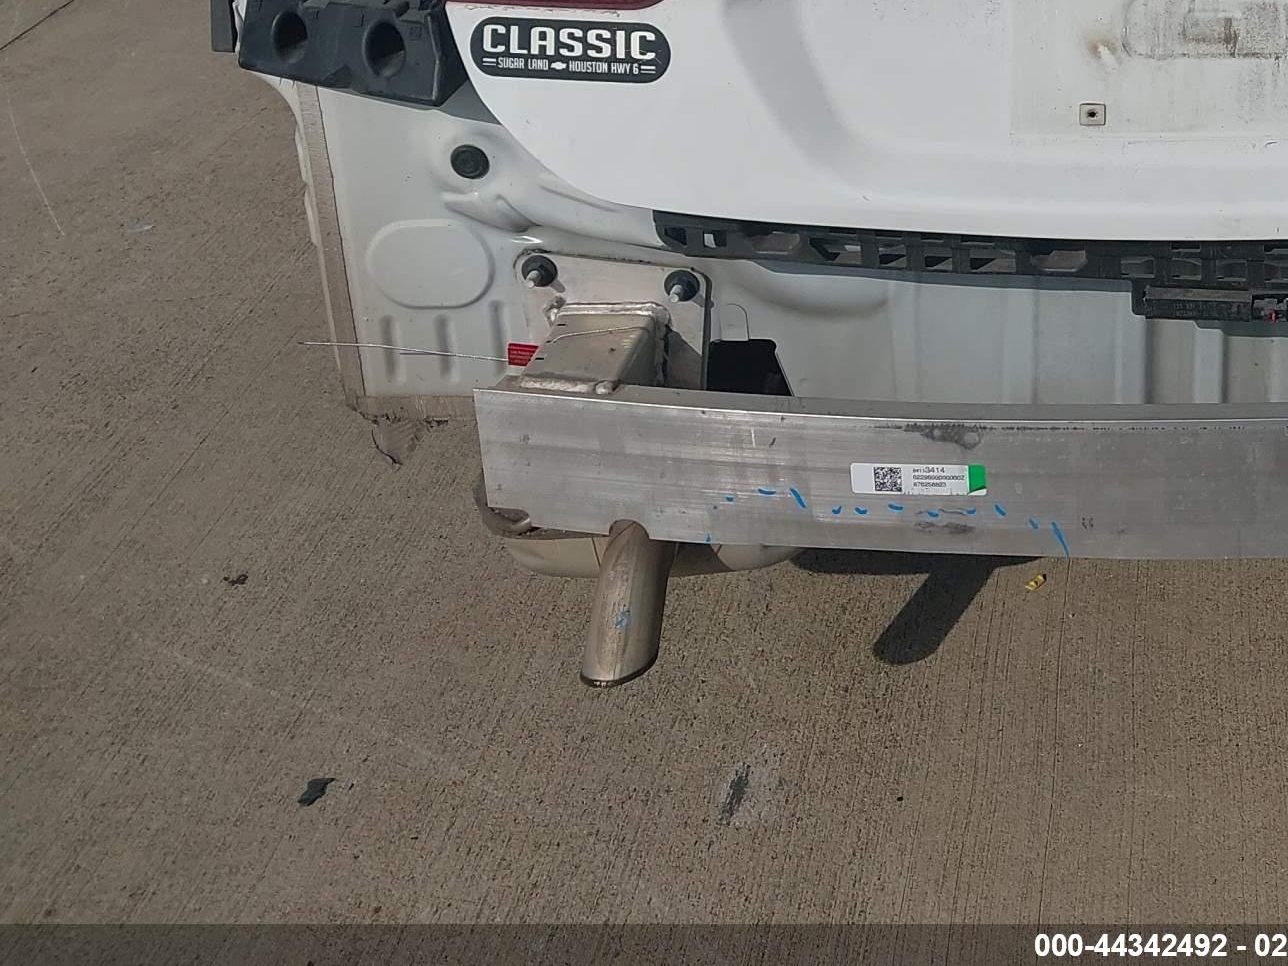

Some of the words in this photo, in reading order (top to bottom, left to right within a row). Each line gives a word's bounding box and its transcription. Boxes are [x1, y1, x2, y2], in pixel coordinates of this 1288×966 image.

[482, 24, 656, 60] CLASSIC
[497, 57, 525, 69] SUGAR
[528, 58, 549, 71] LAND
[569, 60, 608, 73] HOUSTON
[611, 63, 631, 74] HWY
[632, 63, 639, 74] 6
